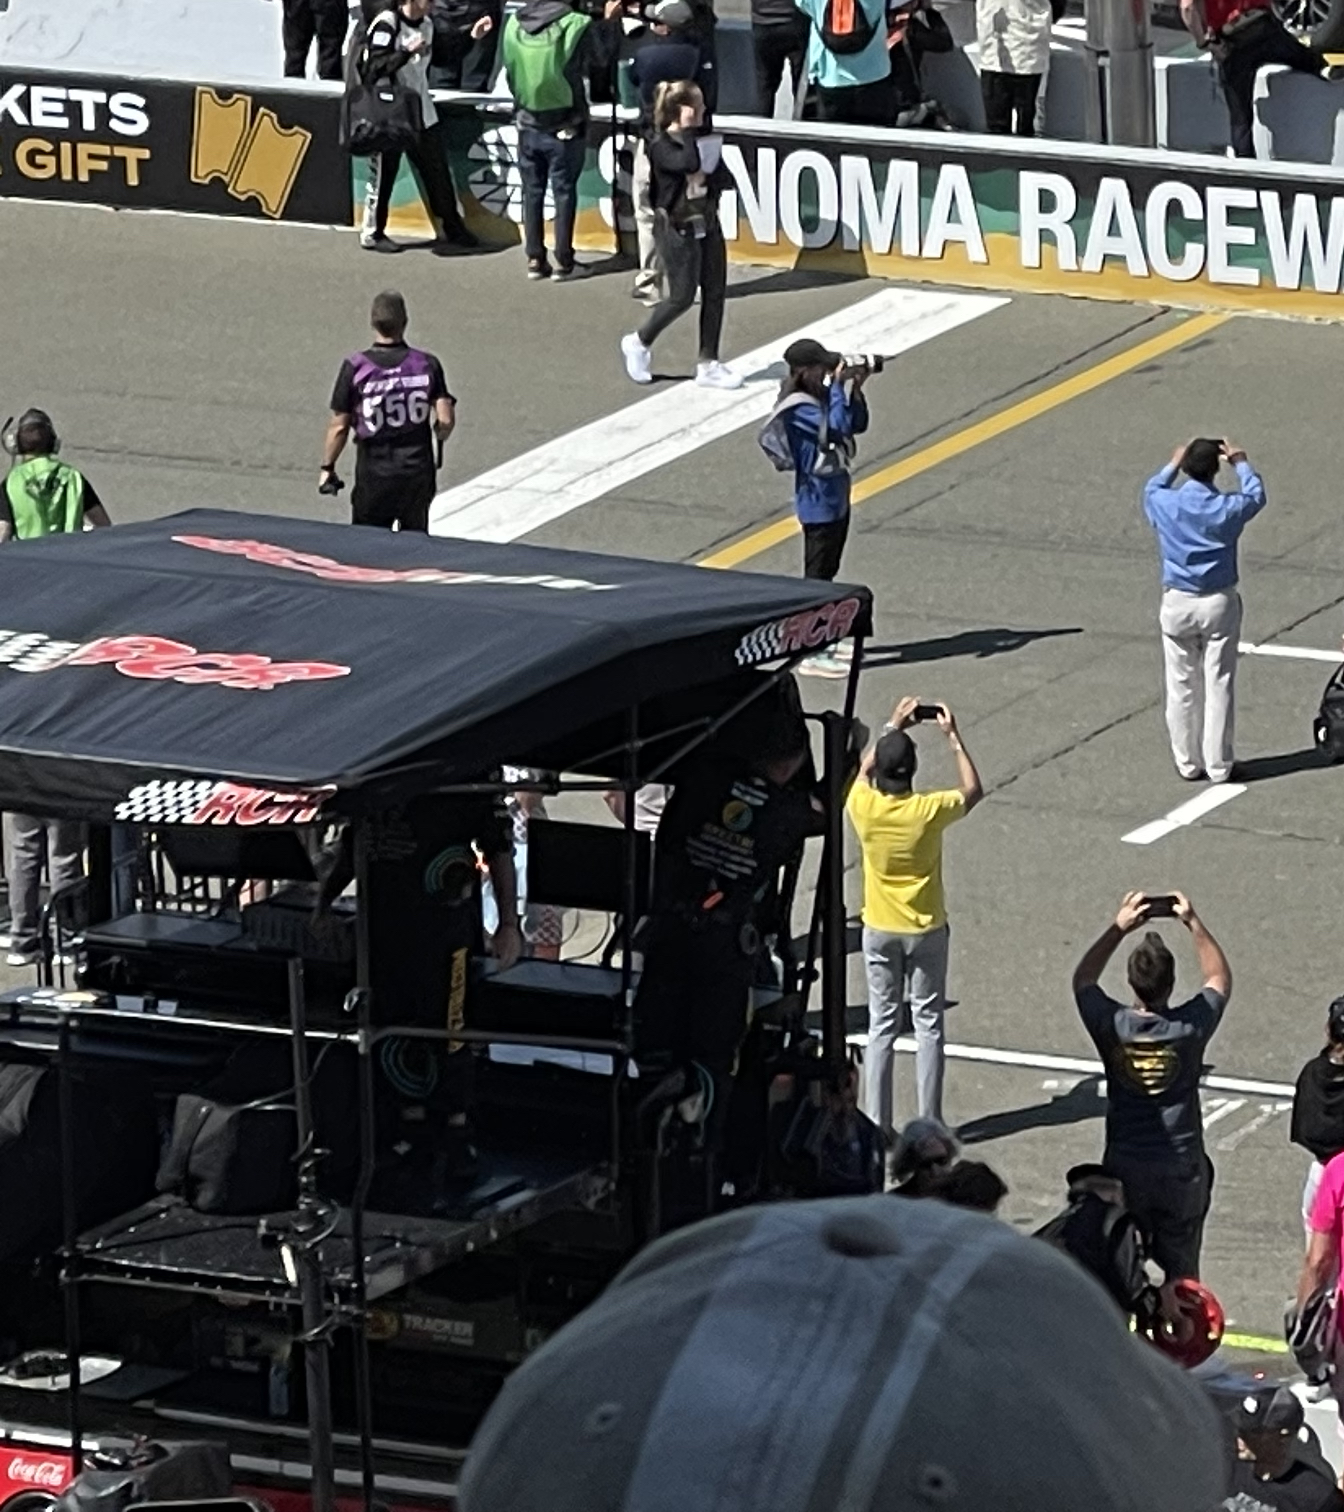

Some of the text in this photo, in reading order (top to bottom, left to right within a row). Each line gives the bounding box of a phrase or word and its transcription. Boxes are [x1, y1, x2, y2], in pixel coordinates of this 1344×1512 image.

[15, 138, 152, 188] GIFT
[598, 133, 989, 265] SNOMA
[362, 389, 430, 434] 556
